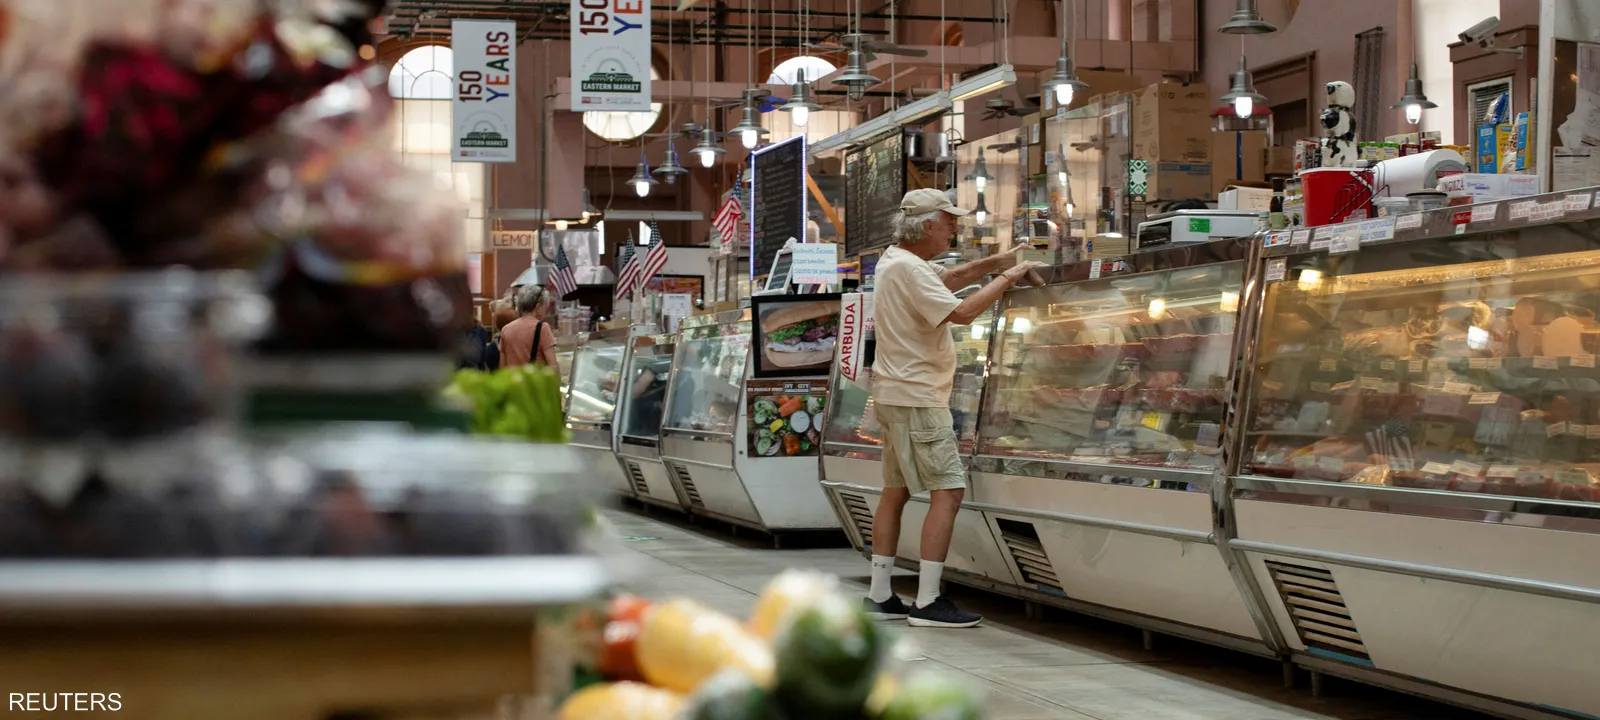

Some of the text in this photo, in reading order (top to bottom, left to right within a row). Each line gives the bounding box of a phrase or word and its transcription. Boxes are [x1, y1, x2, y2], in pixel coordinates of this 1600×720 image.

[459, 70, 482, 102] 150
[486, 31, 509, 102] YEARS
[613, 83, 640, 91] MARKET
[841, 303, 856, 375] BARBUDA
